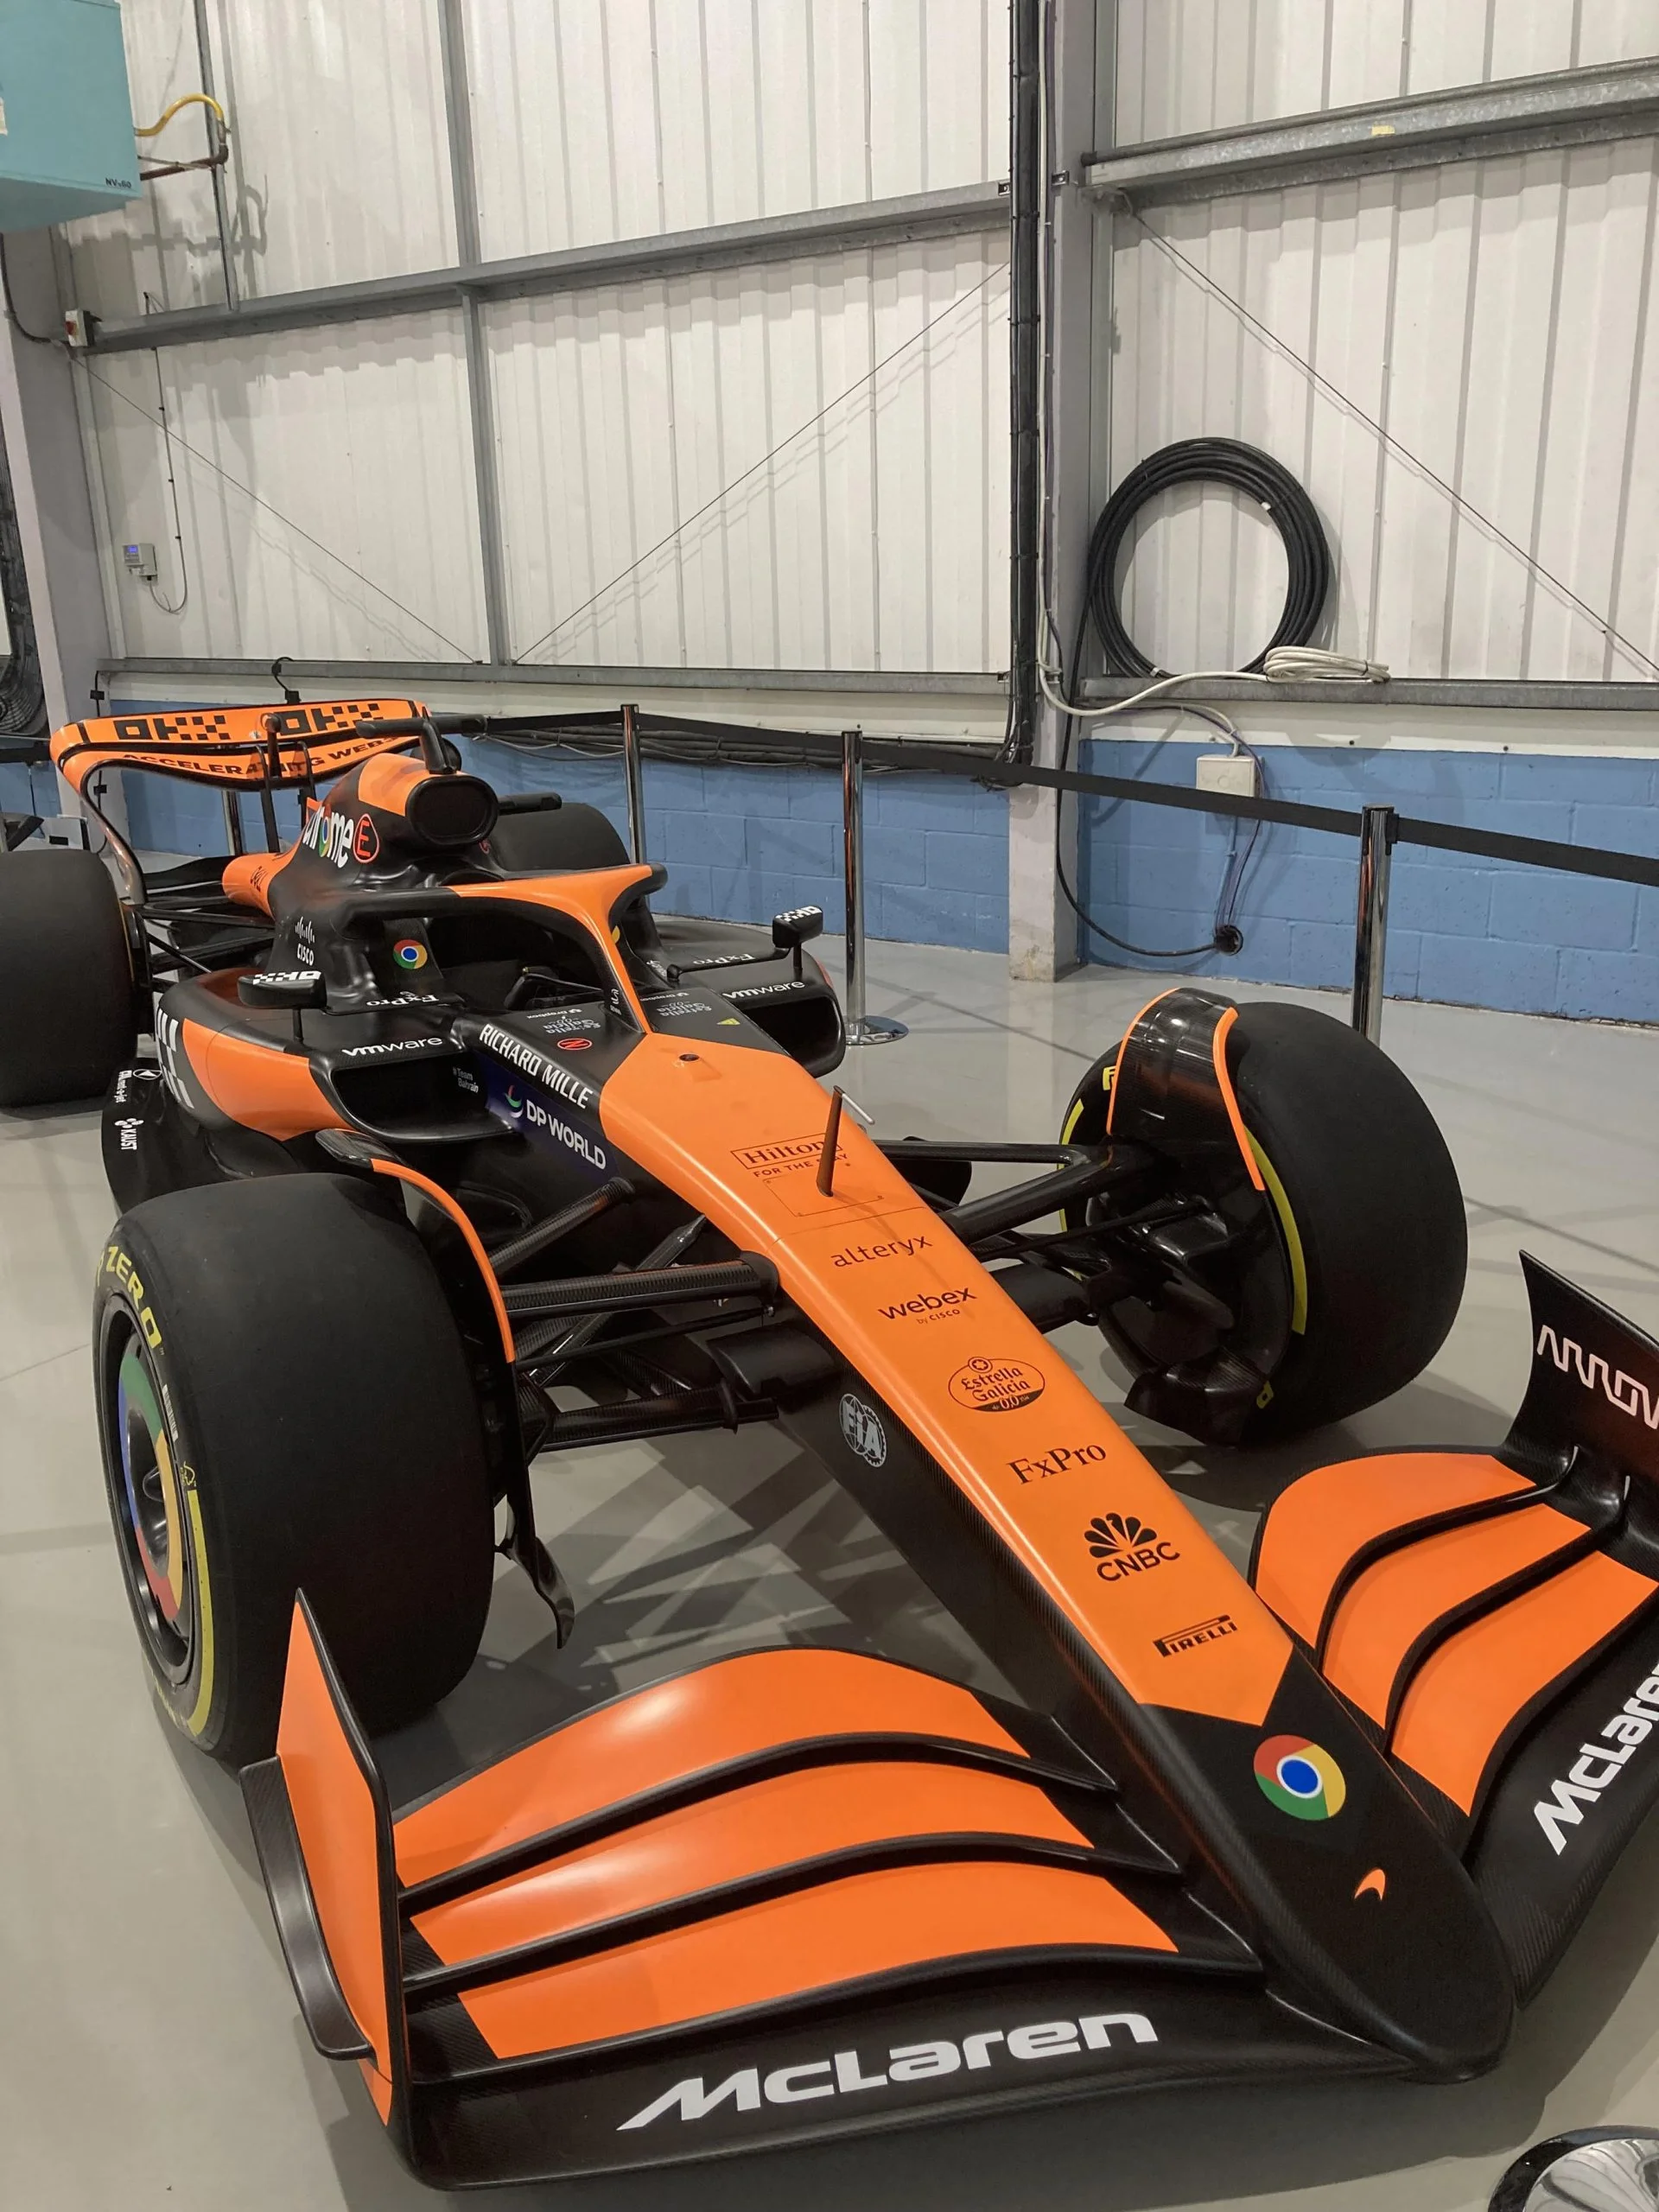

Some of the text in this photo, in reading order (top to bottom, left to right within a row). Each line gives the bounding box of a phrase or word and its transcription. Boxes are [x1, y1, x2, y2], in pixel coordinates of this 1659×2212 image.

[113, 715, 231, 741] OKX
[722, 981, 805, 999] vmware
[342, 1037, 442, 1057] vmware
[480, 1024, 594, 1109] RICHARD MILLE
[121, 1128, 137, 1150] KAUST
[526, 1099, 606, 1170] DP WORLD
[743, 1140, 825, 1164] Hilton
[753, 1167, 781, 1177] FOR
[784, 1160, 813, 1171] THE
[831, 1236, 932, 1268] alteryx
[105, 1246, 162, 1349] ZERO
[878, 1287, 977, 1319] webex
[929, 1309, 960, 1321] CISCO
[961, 1368, 1023, 1390] Estrella
[972, 1380, 1030, 1402] Galicia
[842, 1401, 881, 1459] FIA
[1006, 1445, 1107, 1484] FxPro
[1096, 1541, 1180, 1581] CNBC
[1153, 1615, 1238, 1658] PIRELLI
[1534, 1661, 1659, 1856] McLare
[616, 2013, 1159, 2132] McLaren
